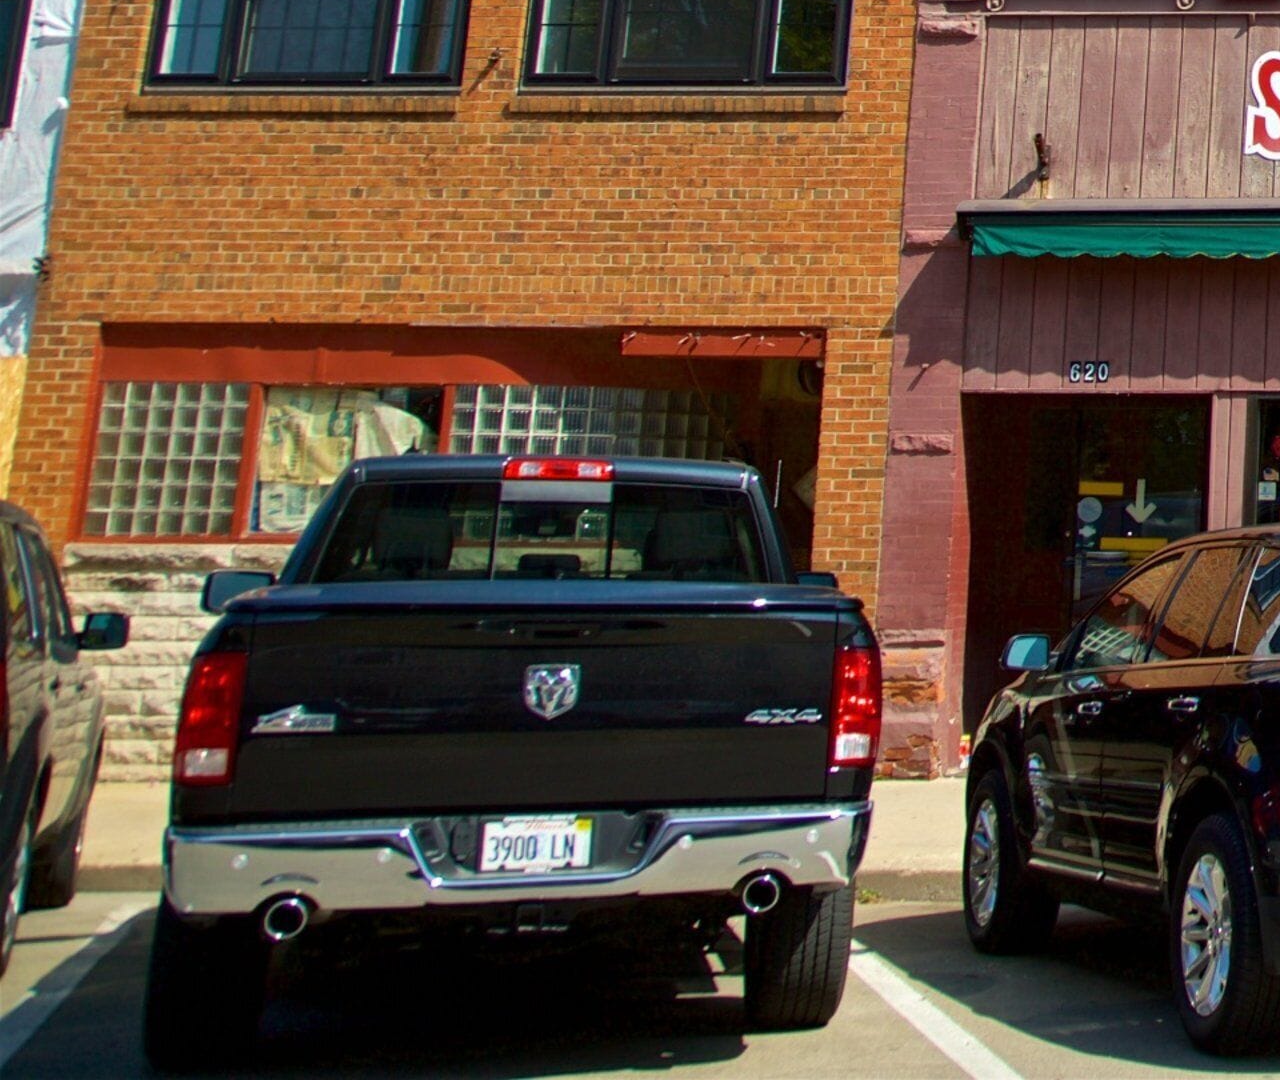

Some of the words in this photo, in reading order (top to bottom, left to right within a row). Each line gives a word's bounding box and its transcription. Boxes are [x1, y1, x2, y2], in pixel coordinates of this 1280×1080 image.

[1070, 363, 1109, 382] 620
[488, 835, 538, 862] 3900
[551, 833, 576, 860] LN
